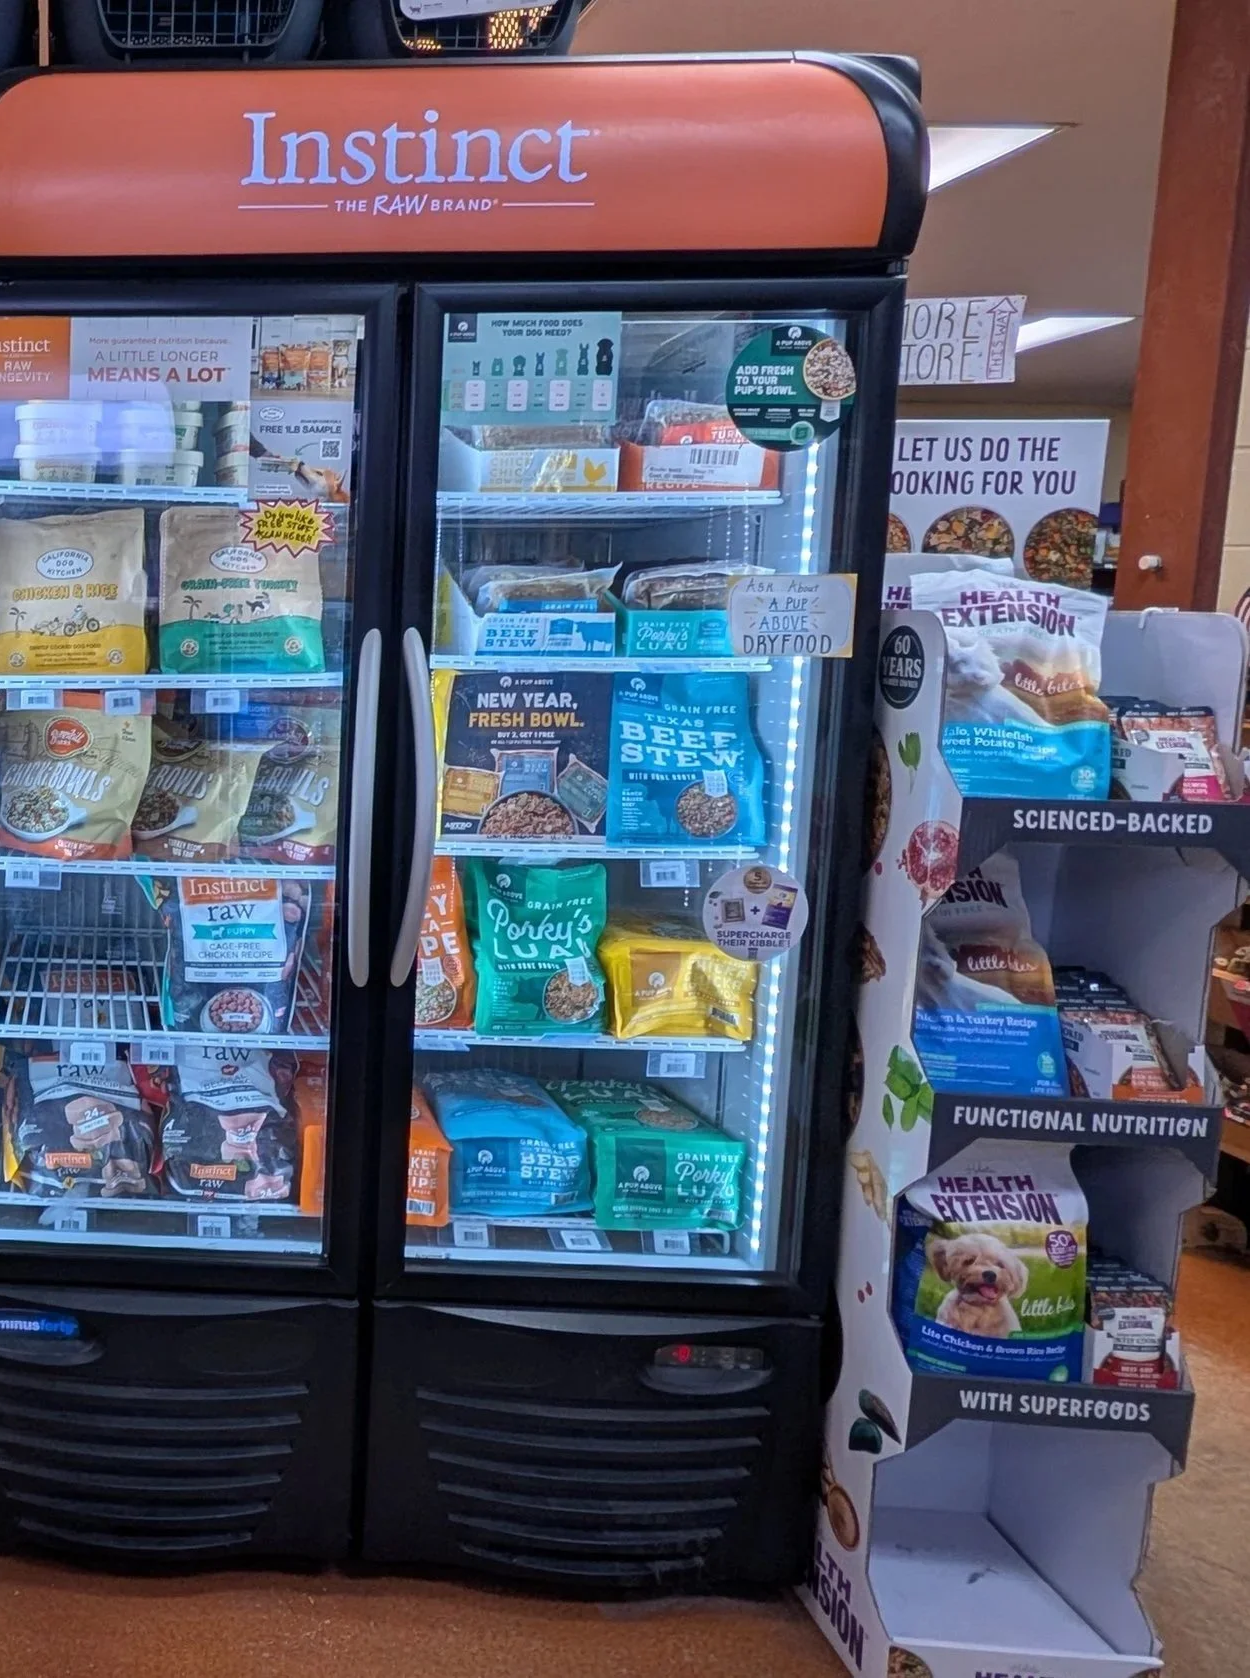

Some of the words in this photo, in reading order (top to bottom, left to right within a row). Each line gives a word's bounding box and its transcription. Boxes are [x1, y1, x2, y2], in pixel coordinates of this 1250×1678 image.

[240, 109, 591, 185] Instinct
[334, 200, 367, 213] THE
[373, 194, 428, 216] RAW
[430, 199, 493, 212] BRAND
[562, 319, 583, 327] DOES
[991, 310, 1008, 337] WAY
[502, 329, 524, 337] YOUR
[526, 329, 543, 337] DOG
[545, 329, 572, 337] NEED?
[95, 351, 105, 361] A
[110, 350, 154, 362] LITTLE
[161, 351, 218, 362] LONGER
[901, 341, 979, 382] TORE
[989, 340, 1005, 375] THIS
[4, 361, 32, 371] RAW
[736, 366, 758, 375] ADD
[761, 365, 794, 375] FRESH
[88, 367, 160, 382] MEANS
[166, 368, 180, 382] A
[187, 368, 225, 382] LOT
[736, 376, 749, 385] TO
[752, 376, 777, 385] YOUR
[734, 386, 763, 395] PUP'S
[766, 385, 797, 395] BOWL.
[260, 425, 282, 433] FREE
[285, 425, 300, 433] 1LB
[302, 425, 342, 434] SAMPLE
[897, 437, 938, 461] LET
[944, 437, 973, 462] US
[980, 437, 1010, 461] DO
[1017, 437, 1061, 461] THE
[891, 471, 974, 494] OOKING
[981, 471, 1024, 494] FOR
[1032, 470, 1076, 494] YOU
[42, 551, 89, 564] CALIFORNIA
[47, 567, 83, 576] KITCHEN
[181, 578, 250, 590] GRAIN-FREE
[253, 579, 298, 590] TURKEY
[13, 585, 70, 602] CHICKEN
[72, 583, 84, 599] &
[86, 583, 118, 599] RICE
[960, 590, 1061, 609] HEALTH
[769, 598, 778, 608] A
[785, 597, 808, 608] PUP
[759, 616, 808, 630] ABOVE
[941, 603, 1076, 638] EXTENSION
[486, 629, 539, 637] BEEF
[485, 639, 535, 647] STEW
[636, 642, 688, 650] LUAU
[894, 635, 910, 655] 60
[882, 656, 922, 679] YEARS
[477, 693, 516, 708] NEW
[523, 693, 578, 709] YEAR,
[664, 704, 701, 714] GRAIN
[706, 705, 736, 714] FREE
[469, 712, 525, 728] FRESH
[530, 712, 585, 728] BOWL.
[644, 713, 704, 728] TEXAS
[619, 720, 738, 749] BEEF
[974, 727, 1034, 742] Whitefish
[620, 742, 744, 768] STEW
[1013, 809, 1213, 834] SCIENCED-BACKED
[188, 877, 269, 896] Instinct
[527, 900, 562, 911] GRAIN
[566, 897, 593, 908] FREE
[208, 903, 255, 921] raw
[487, 899, 592, 949] Porky's
[717, 930, 791, 940] SUPERCHARGE
[209, 942, 260, 950] CAGE-FREE
[494, 937, 591, 960] LUAU
[717, 939, 746, 947] THEIR
[198, 951, 240, 959] CHICKEN
[242, 951, 273, 959] RECIPE
[956, 1014, 964, 1023] &
[967, 1016, 1004, 1027] Turkey
[1006, 1016, 1038, 1028] Recipe
[954, 1106, 1085, 1131] FUNCTIONAL
[1092, 1113, 1208, 1137] NUTRITION
[521, 1153, 581, 1167] BEEF
[677, 1153, 711, 1161] GRAIN
[715, 1154, 739, 1163] FREE
[194, 1166, 233, 1177] Instinct
[520, 1166, 576, 1180] STEW
[938, 1176, 1034, 1193] HEALTH
[931, 1194, 1063, 1225] EXTENSION
[922, 1325, 941, 1340] Lite
[943, 1332, 984, 1352] Chicken
[986, 1344, 993, 1352] &
[995, 1346, 1025, 1355] Brown
[1027, 1347, 1044, 1355] Rice
[960, 1390, 1013, 1411] WITH
[1020, 1394, 1150, 1421] SUPERFOODS
